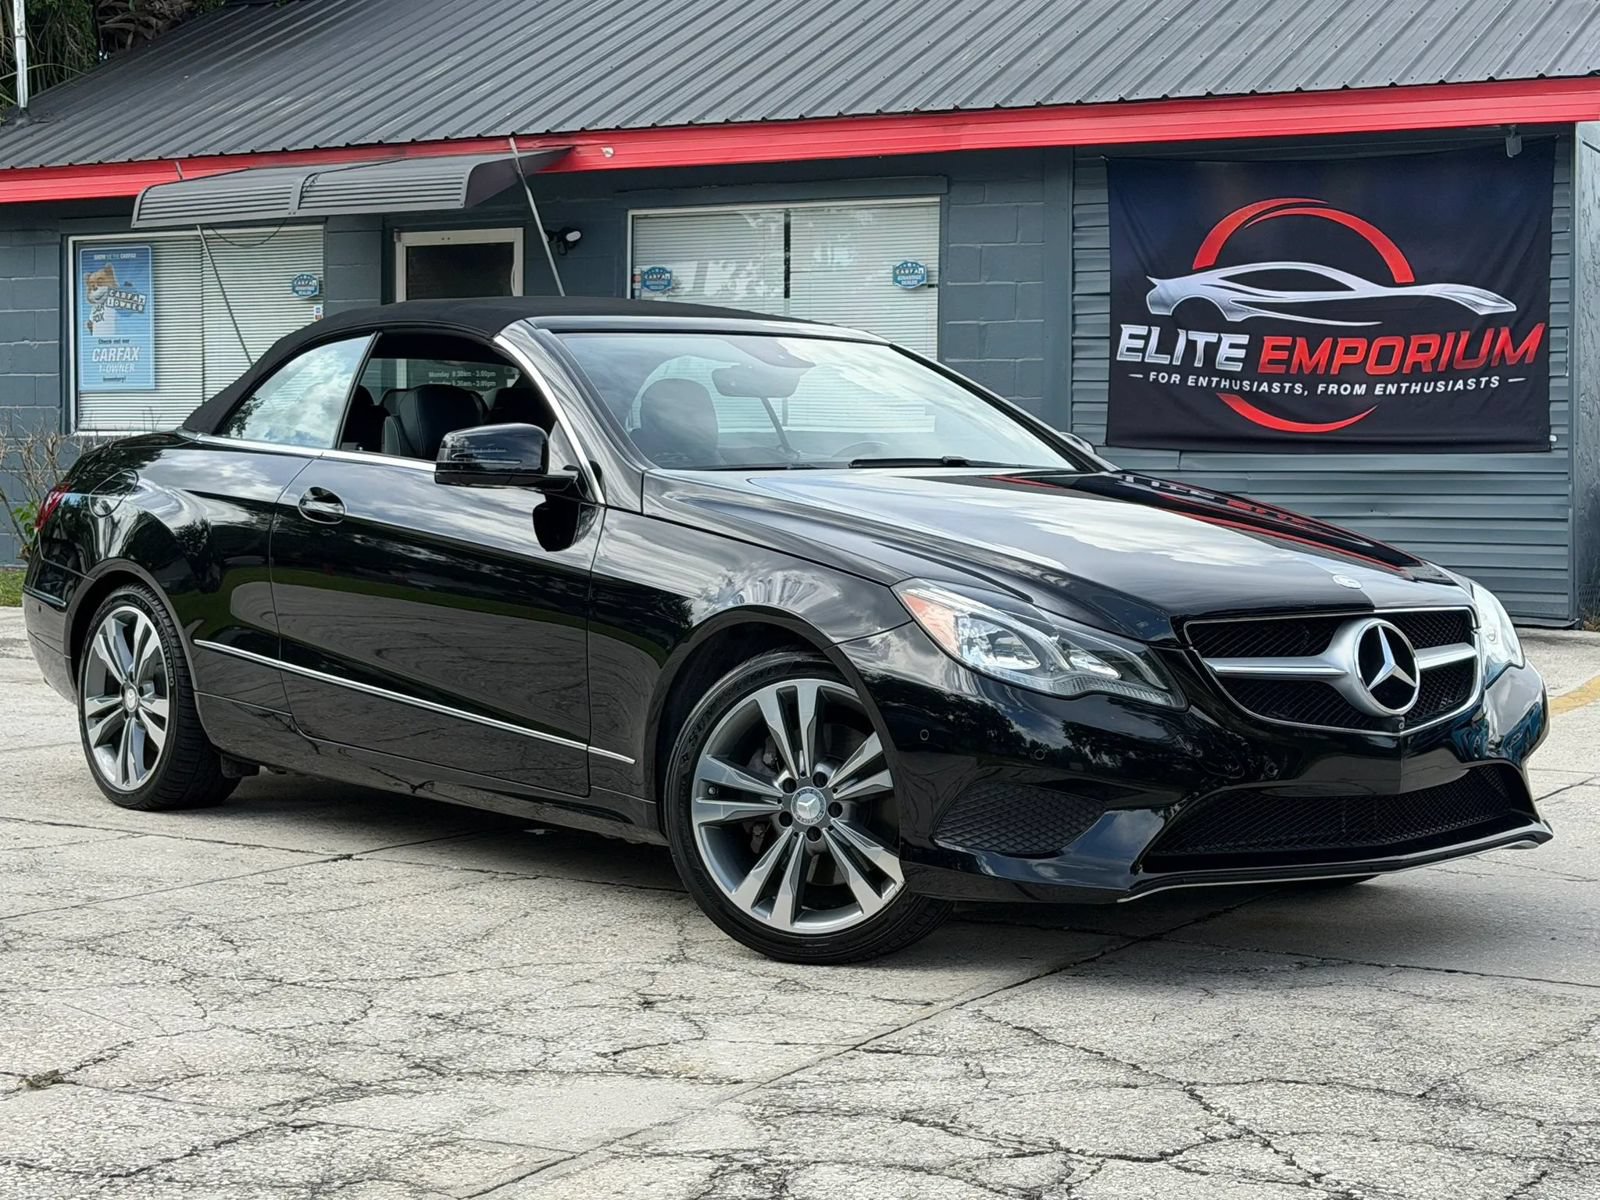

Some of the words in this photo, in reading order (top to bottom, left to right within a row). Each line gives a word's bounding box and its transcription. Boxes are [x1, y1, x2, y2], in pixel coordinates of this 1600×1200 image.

[92, 347, 139, 362] CARFAX
[1116, 323, 1250, 371] ELITE
[1257, 322, 1546, 376] EMPORIUM
[1149, 372, 1181, 385] FOR
[1187, 375, 1309, 396] ENTHUSIASTS,
[1317, 383, 1367, 396] FROM
[1375, 376, 1500, 396] ENTHUSIASTS
